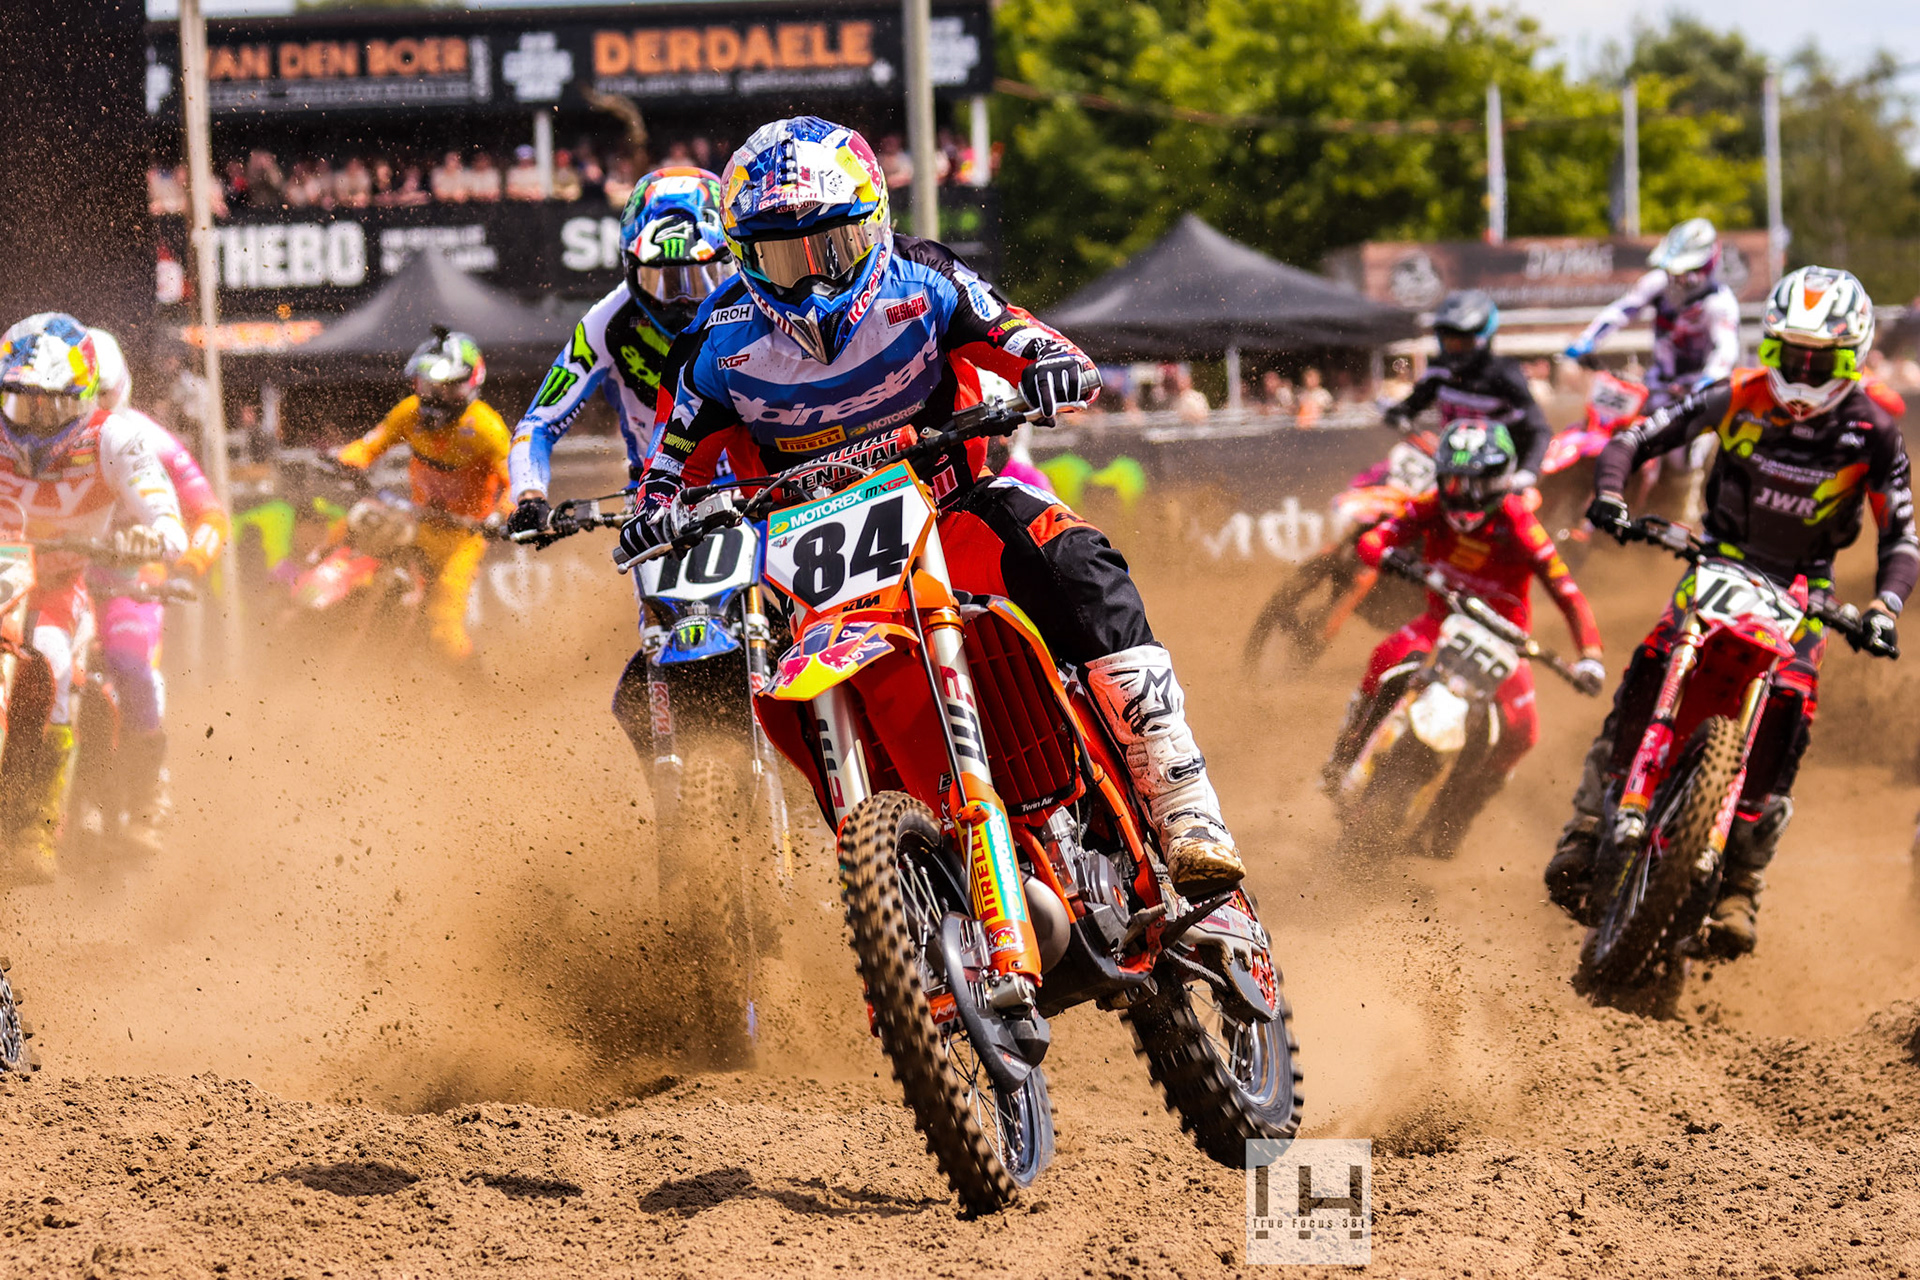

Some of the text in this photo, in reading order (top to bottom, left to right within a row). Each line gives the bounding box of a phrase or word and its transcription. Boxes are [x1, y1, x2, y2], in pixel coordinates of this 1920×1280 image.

[280, 42, 358, 75] DEN
[367, 38, 466, 76] BOER
[593, 21, 872, 75] DERDAELE
[779, 428, 842, 451] PIRELLI
[867, 401, 923, 432] MOTOREX
[790, 491, 864, 528] MOTOREX
[865, 475, 909, 499] MXGP
[656, 527, 744, 593] 10
[793, 494, 909, 608] 84
[842, 595, 880, 612] KTM
[1699, 577, 1797, 622] 10
[652, 681, 672, 734] KYB
[1021, 796, 1054, 812] Twin Air
[966, 828, 998, 923] PIRELLI
[988, 814, 1019, 896] MOTOREX
